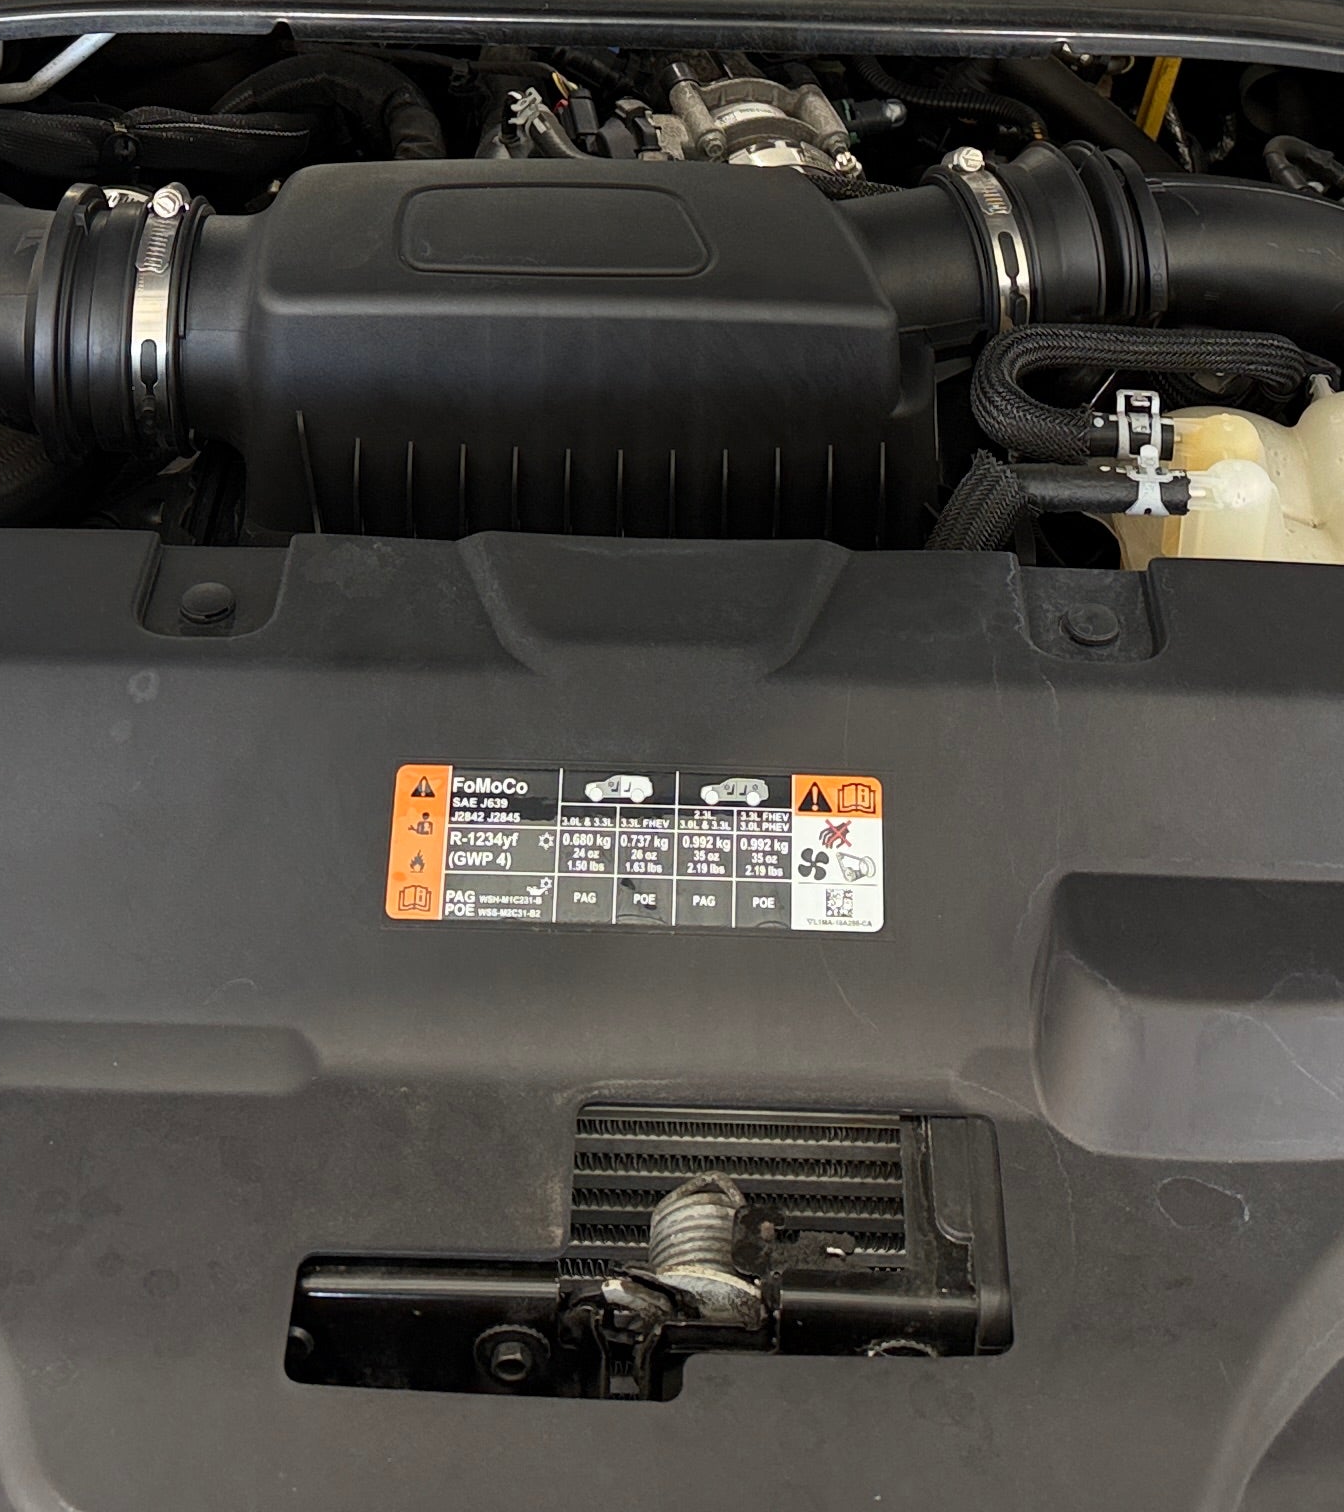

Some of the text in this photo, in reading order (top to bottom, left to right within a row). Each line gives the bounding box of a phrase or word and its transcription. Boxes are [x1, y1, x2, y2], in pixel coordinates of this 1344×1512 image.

[452, 777, 528, 794] FoMoCo
[452, 797, 509, 809] SAE J639
[451, 811, 521, 823] J2842 J2845
[561, 817, 614, 827] 3.0L & 3.3L
[740, 812, 789, 821] 3.3L FHEV
[621, 819, 670, 828] 3.3L FHEV
[679, 820, 732, 830] 3.0L & 3.3L
[740, 822, 789, 832] 3.0L PHEV
[449, 831, 519, 850] R-1234yf
[562, 833, 611, 850] 0.680 kg
[620, 835, 669, 851] 0.737 kg
[682, 836, 731, 853] 0.992 kg
[740, 838, 789, 854] 0.992 kg
[573, 848, 600, 859] 24 oz
[631, 849, 658, 860] 26 oz
[693, 851, 720, 861] 35 oz
[752, 853, 778, 863] 35 oz
[448, 851, 512, 870] (GWP 4)
[567, 860, 605, 872] 1.50 lbs
[647, 863, 663, 873] lbs
[687, 863, 725, 874] 2.19 lbs
[745, 865, 783, 877] 2.19 lbs
[445, 890, 476, 903] PAG
[573, 892, 597, 904] PAG
[633, 893, 656, 906] POE
[692, 895, 716, 907] PAG
[752, 897, 775, 909] POE
[444, 903, 476, 917] POE
